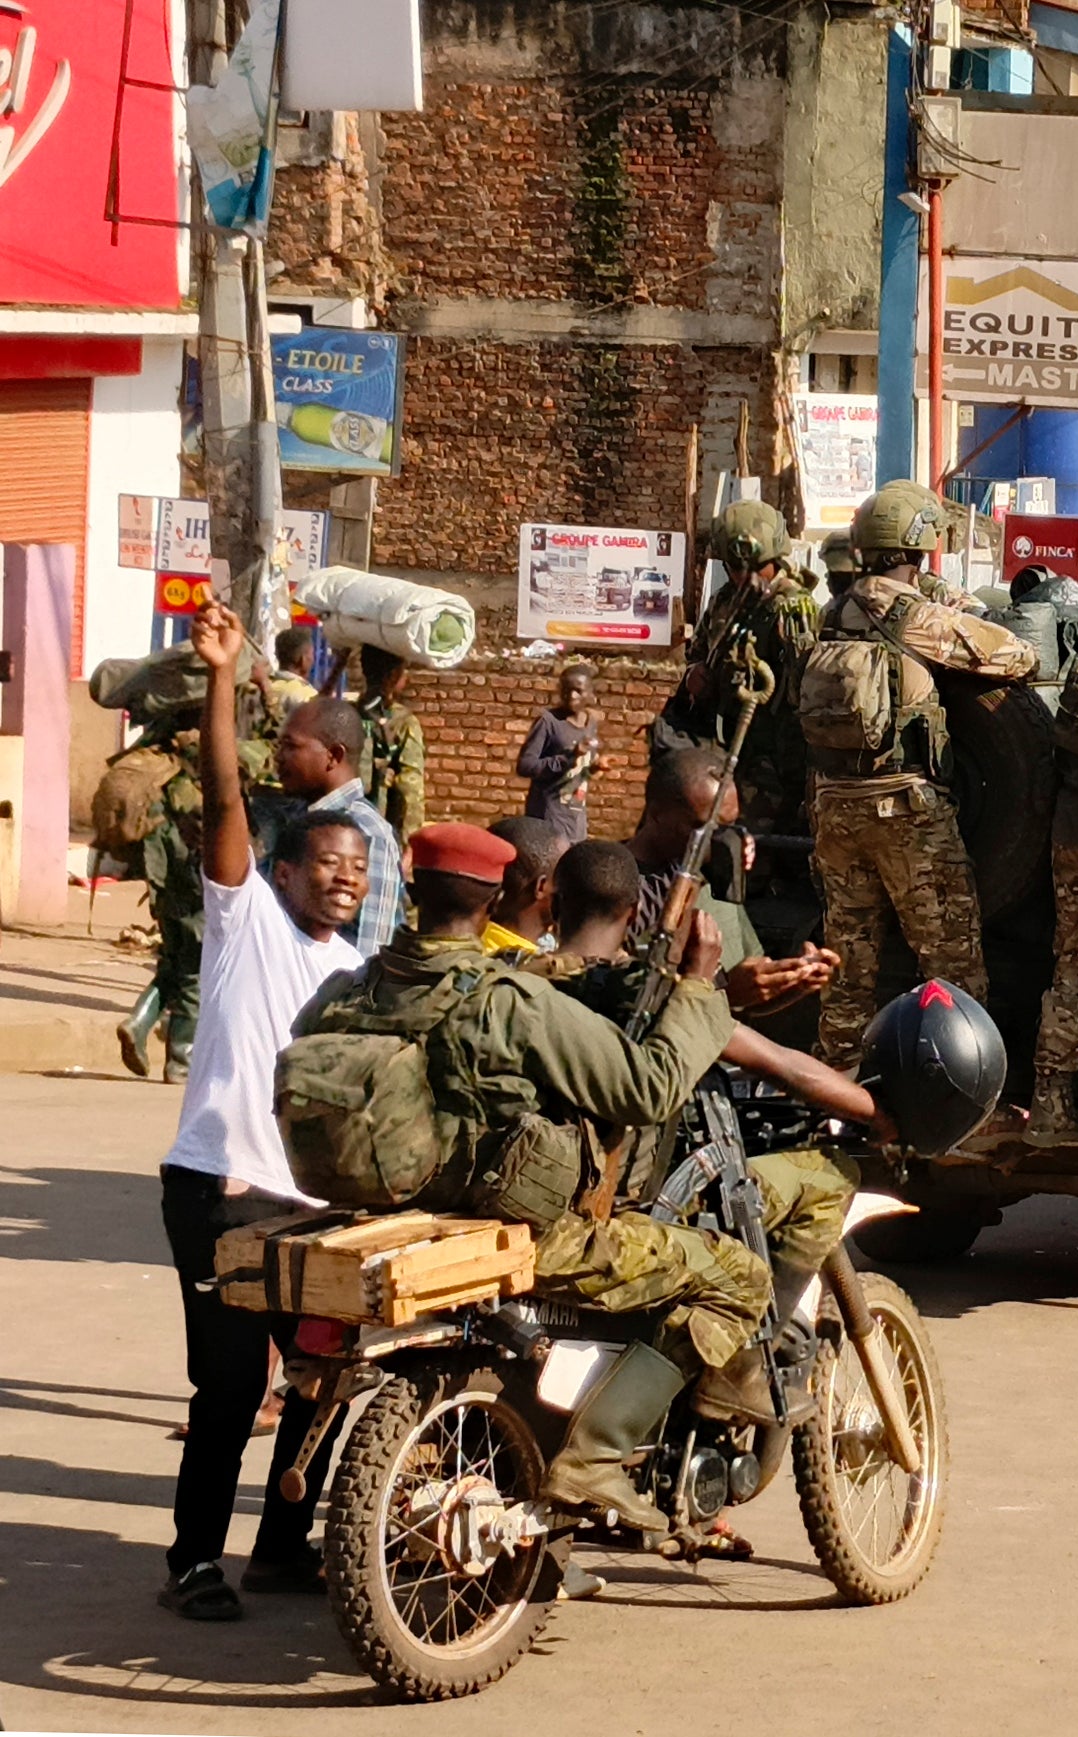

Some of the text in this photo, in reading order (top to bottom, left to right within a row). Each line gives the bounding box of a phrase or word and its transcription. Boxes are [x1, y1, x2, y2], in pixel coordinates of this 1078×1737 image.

[287, 349, 365, 374] ETOILE
[282, 376, 334, 393] CLASS
[1035, 545, 1074, 558] FINCA
